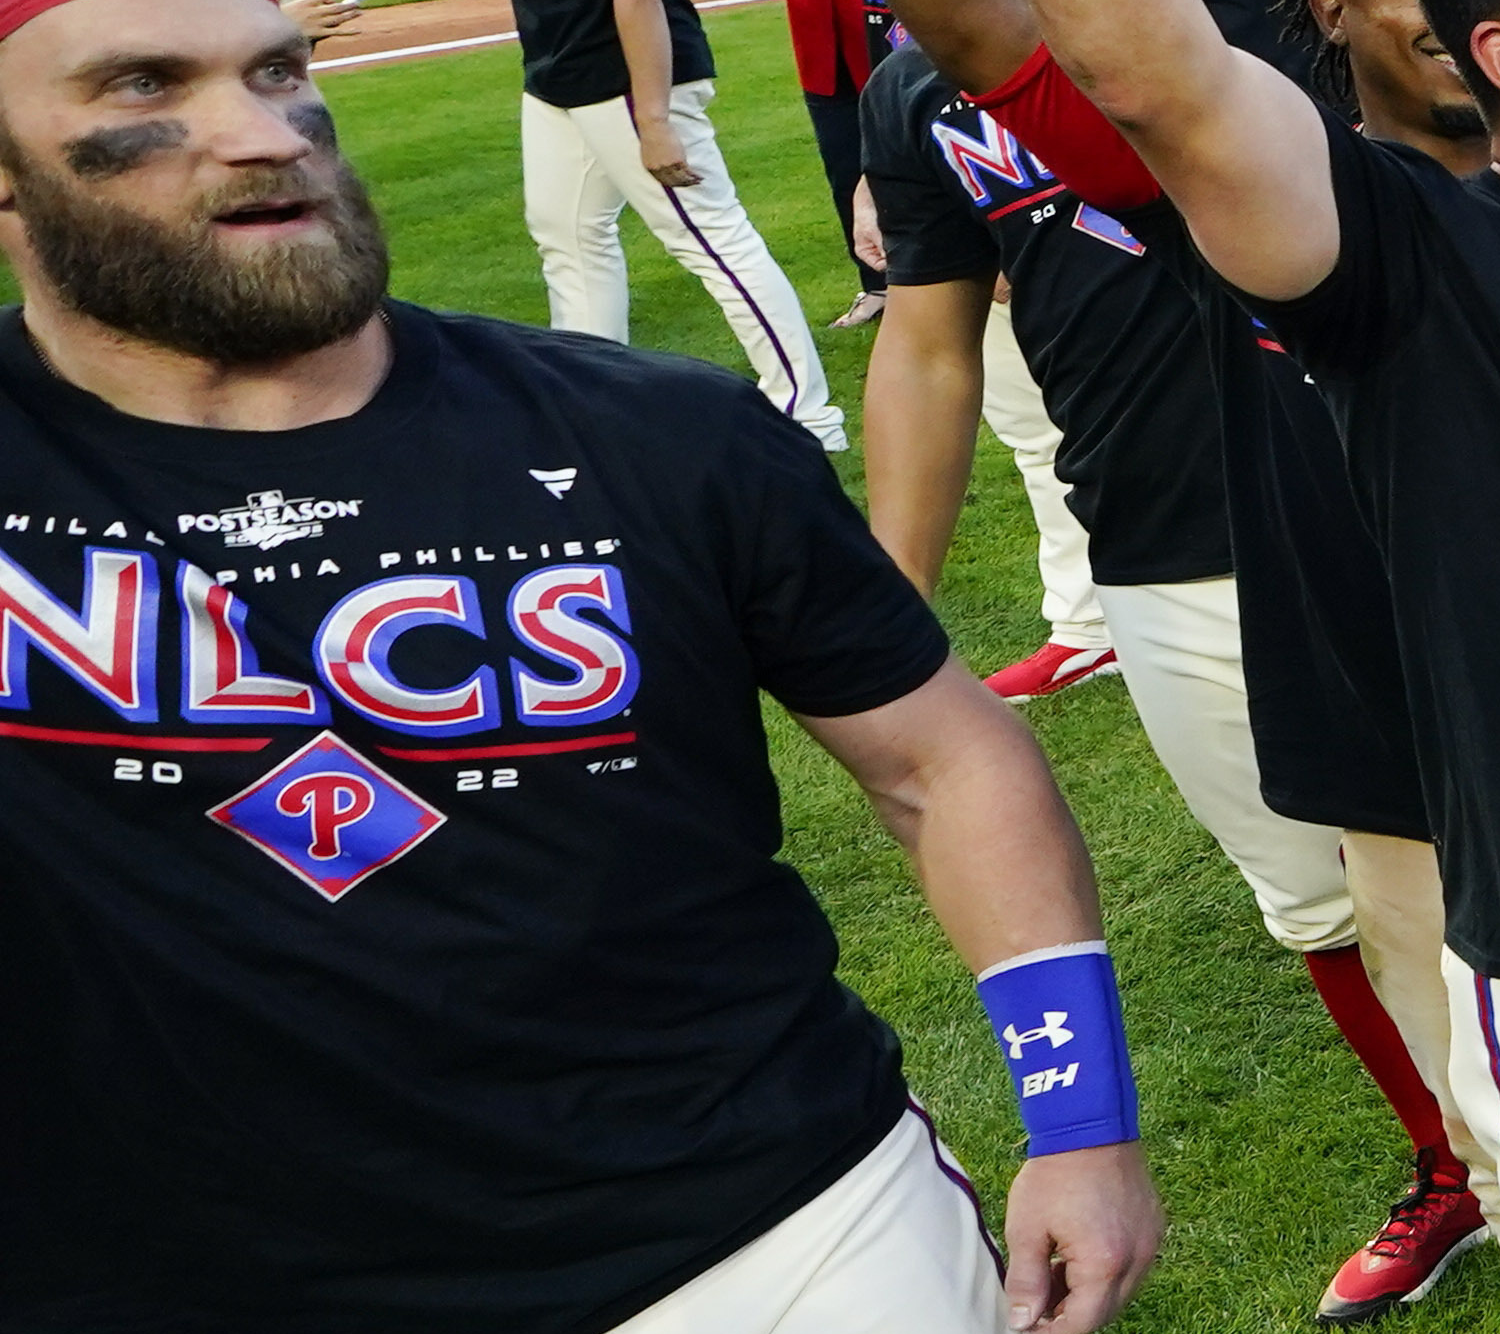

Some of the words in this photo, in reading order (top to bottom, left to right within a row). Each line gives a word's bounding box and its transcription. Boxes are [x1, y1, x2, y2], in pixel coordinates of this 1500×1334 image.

[1031, 203, 1057, 226] 20
[178, 497, 363, 536] POSTSEASON
[379, 538, 620, 570] PHILLIES
[0, 544, 641, 738] NLCS
[114, 757, 183, 785] 20
[455, 768, 520, 793] 22
[275, 769, 376, 861] P
[1021, 1062, 1080, 1099] BH
